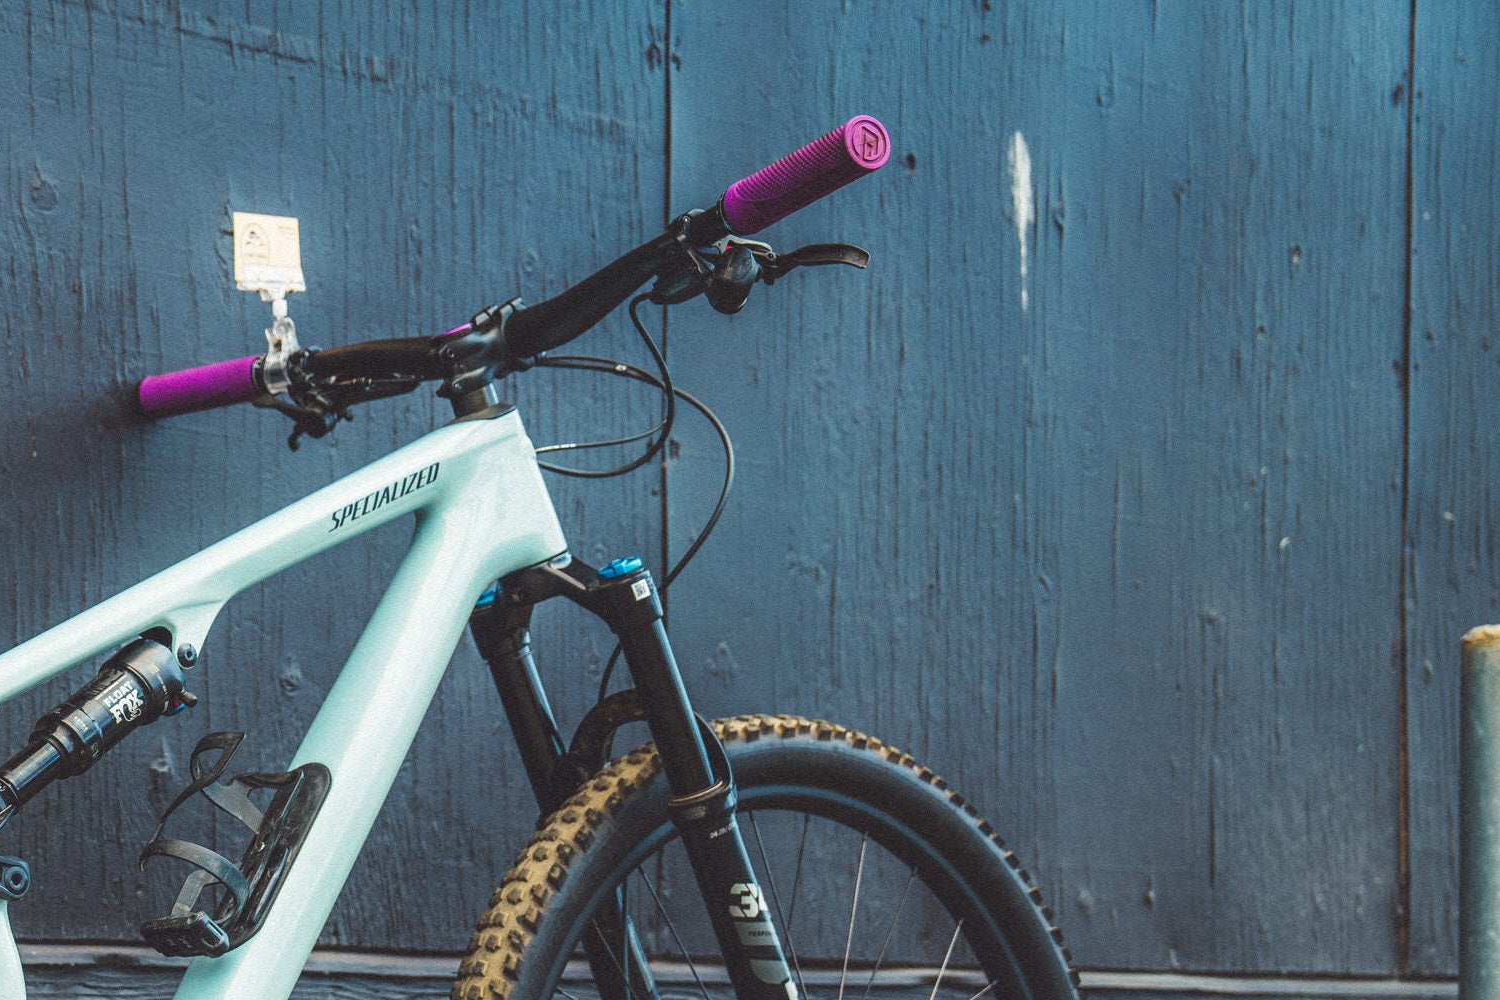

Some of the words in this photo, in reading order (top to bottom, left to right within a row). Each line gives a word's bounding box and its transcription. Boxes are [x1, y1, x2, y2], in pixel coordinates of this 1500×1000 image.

[327, 461, 440, 533] SPECIALIZED
[102, 680, 134, 707] FLOAT
[109, 688, 145, 724] FOX
